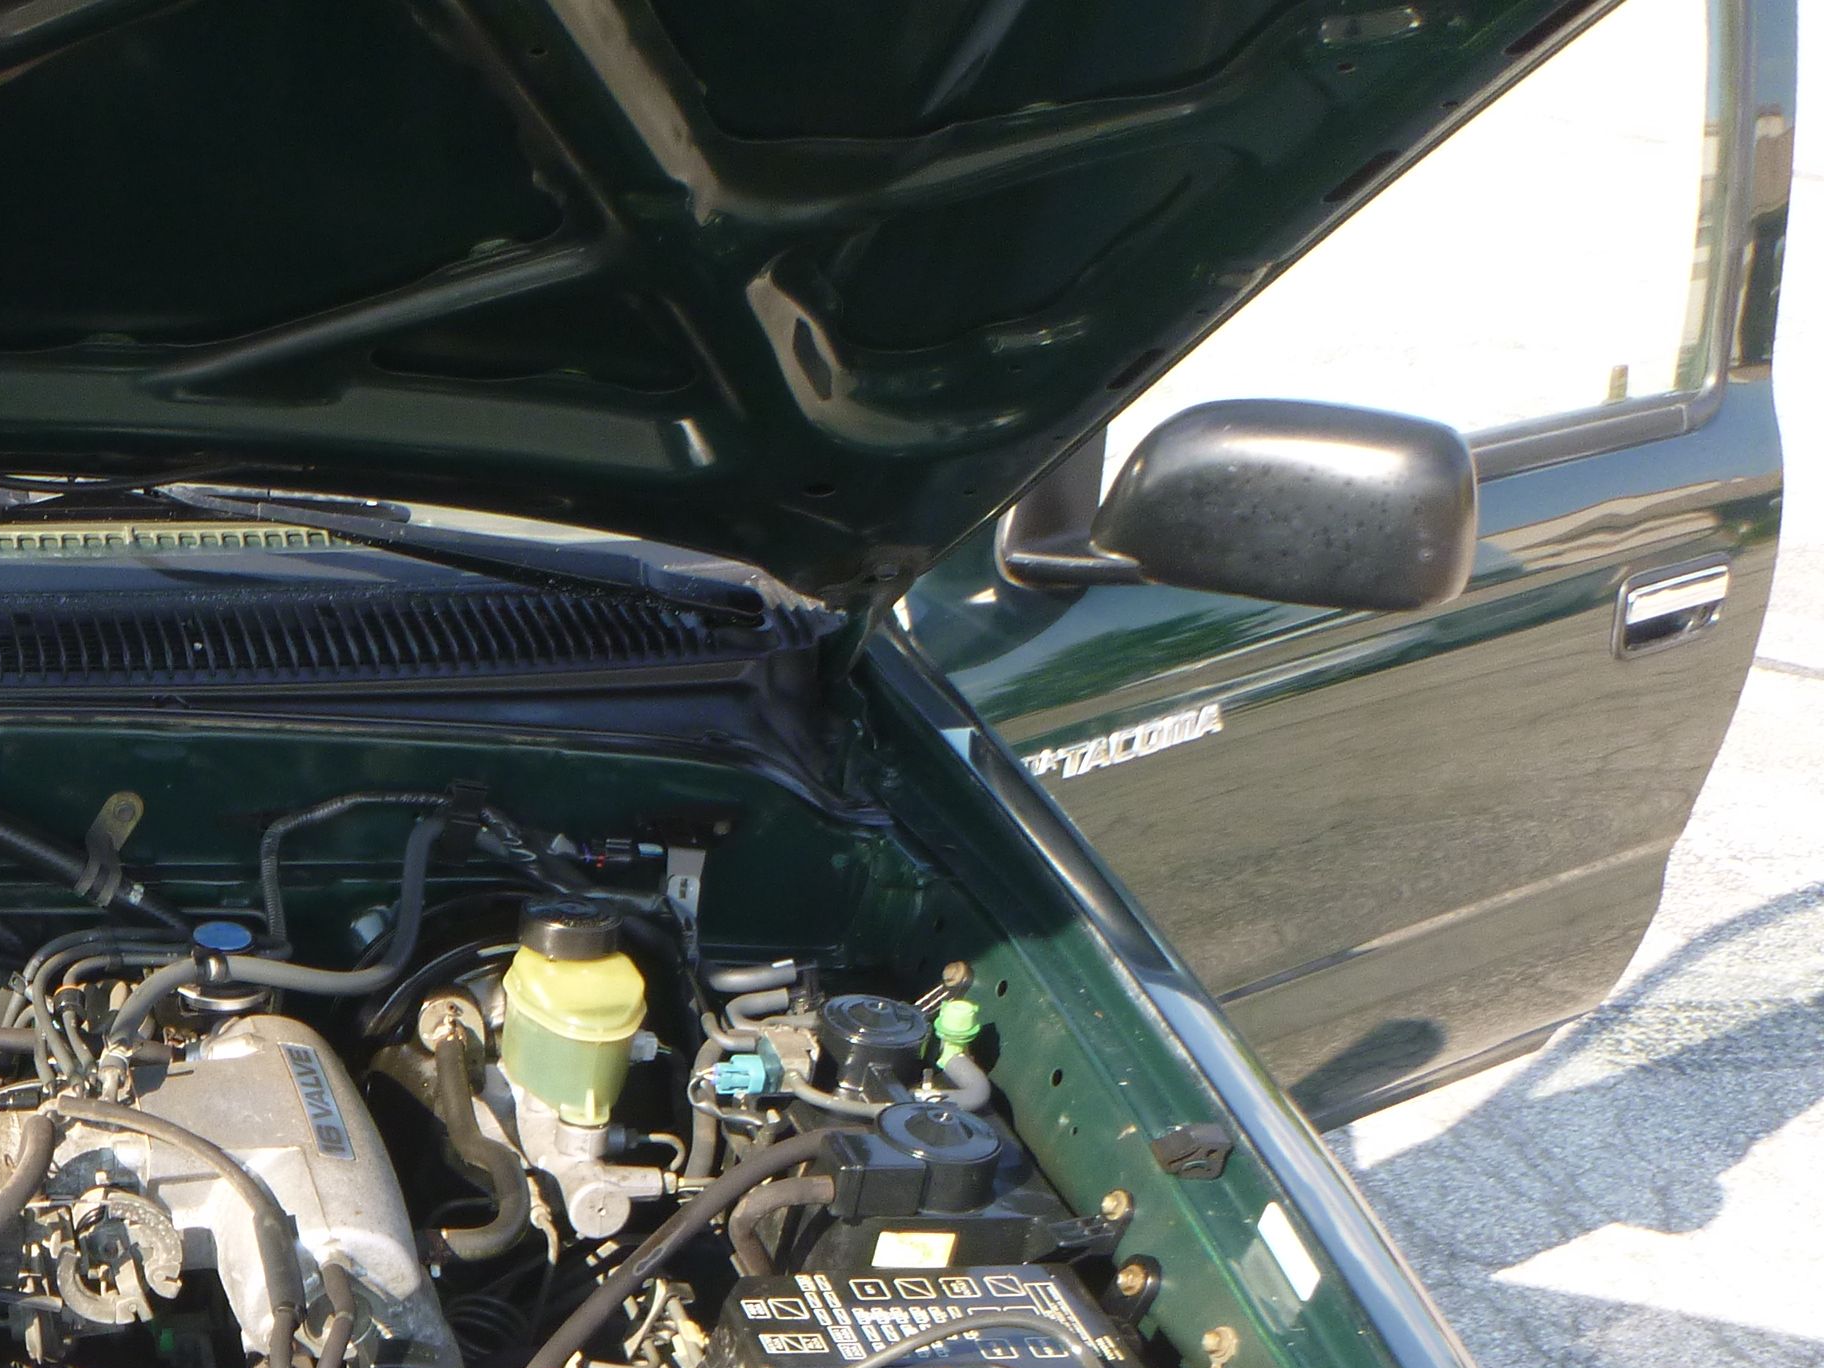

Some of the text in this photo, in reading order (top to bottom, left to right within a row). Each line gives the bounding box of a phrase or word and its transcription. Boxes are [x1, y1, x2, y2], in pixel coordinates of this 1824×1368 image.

[1058, 703, 1225, 779] TACOMA
[286, 1047, 347, 1153] 16 VALVE
